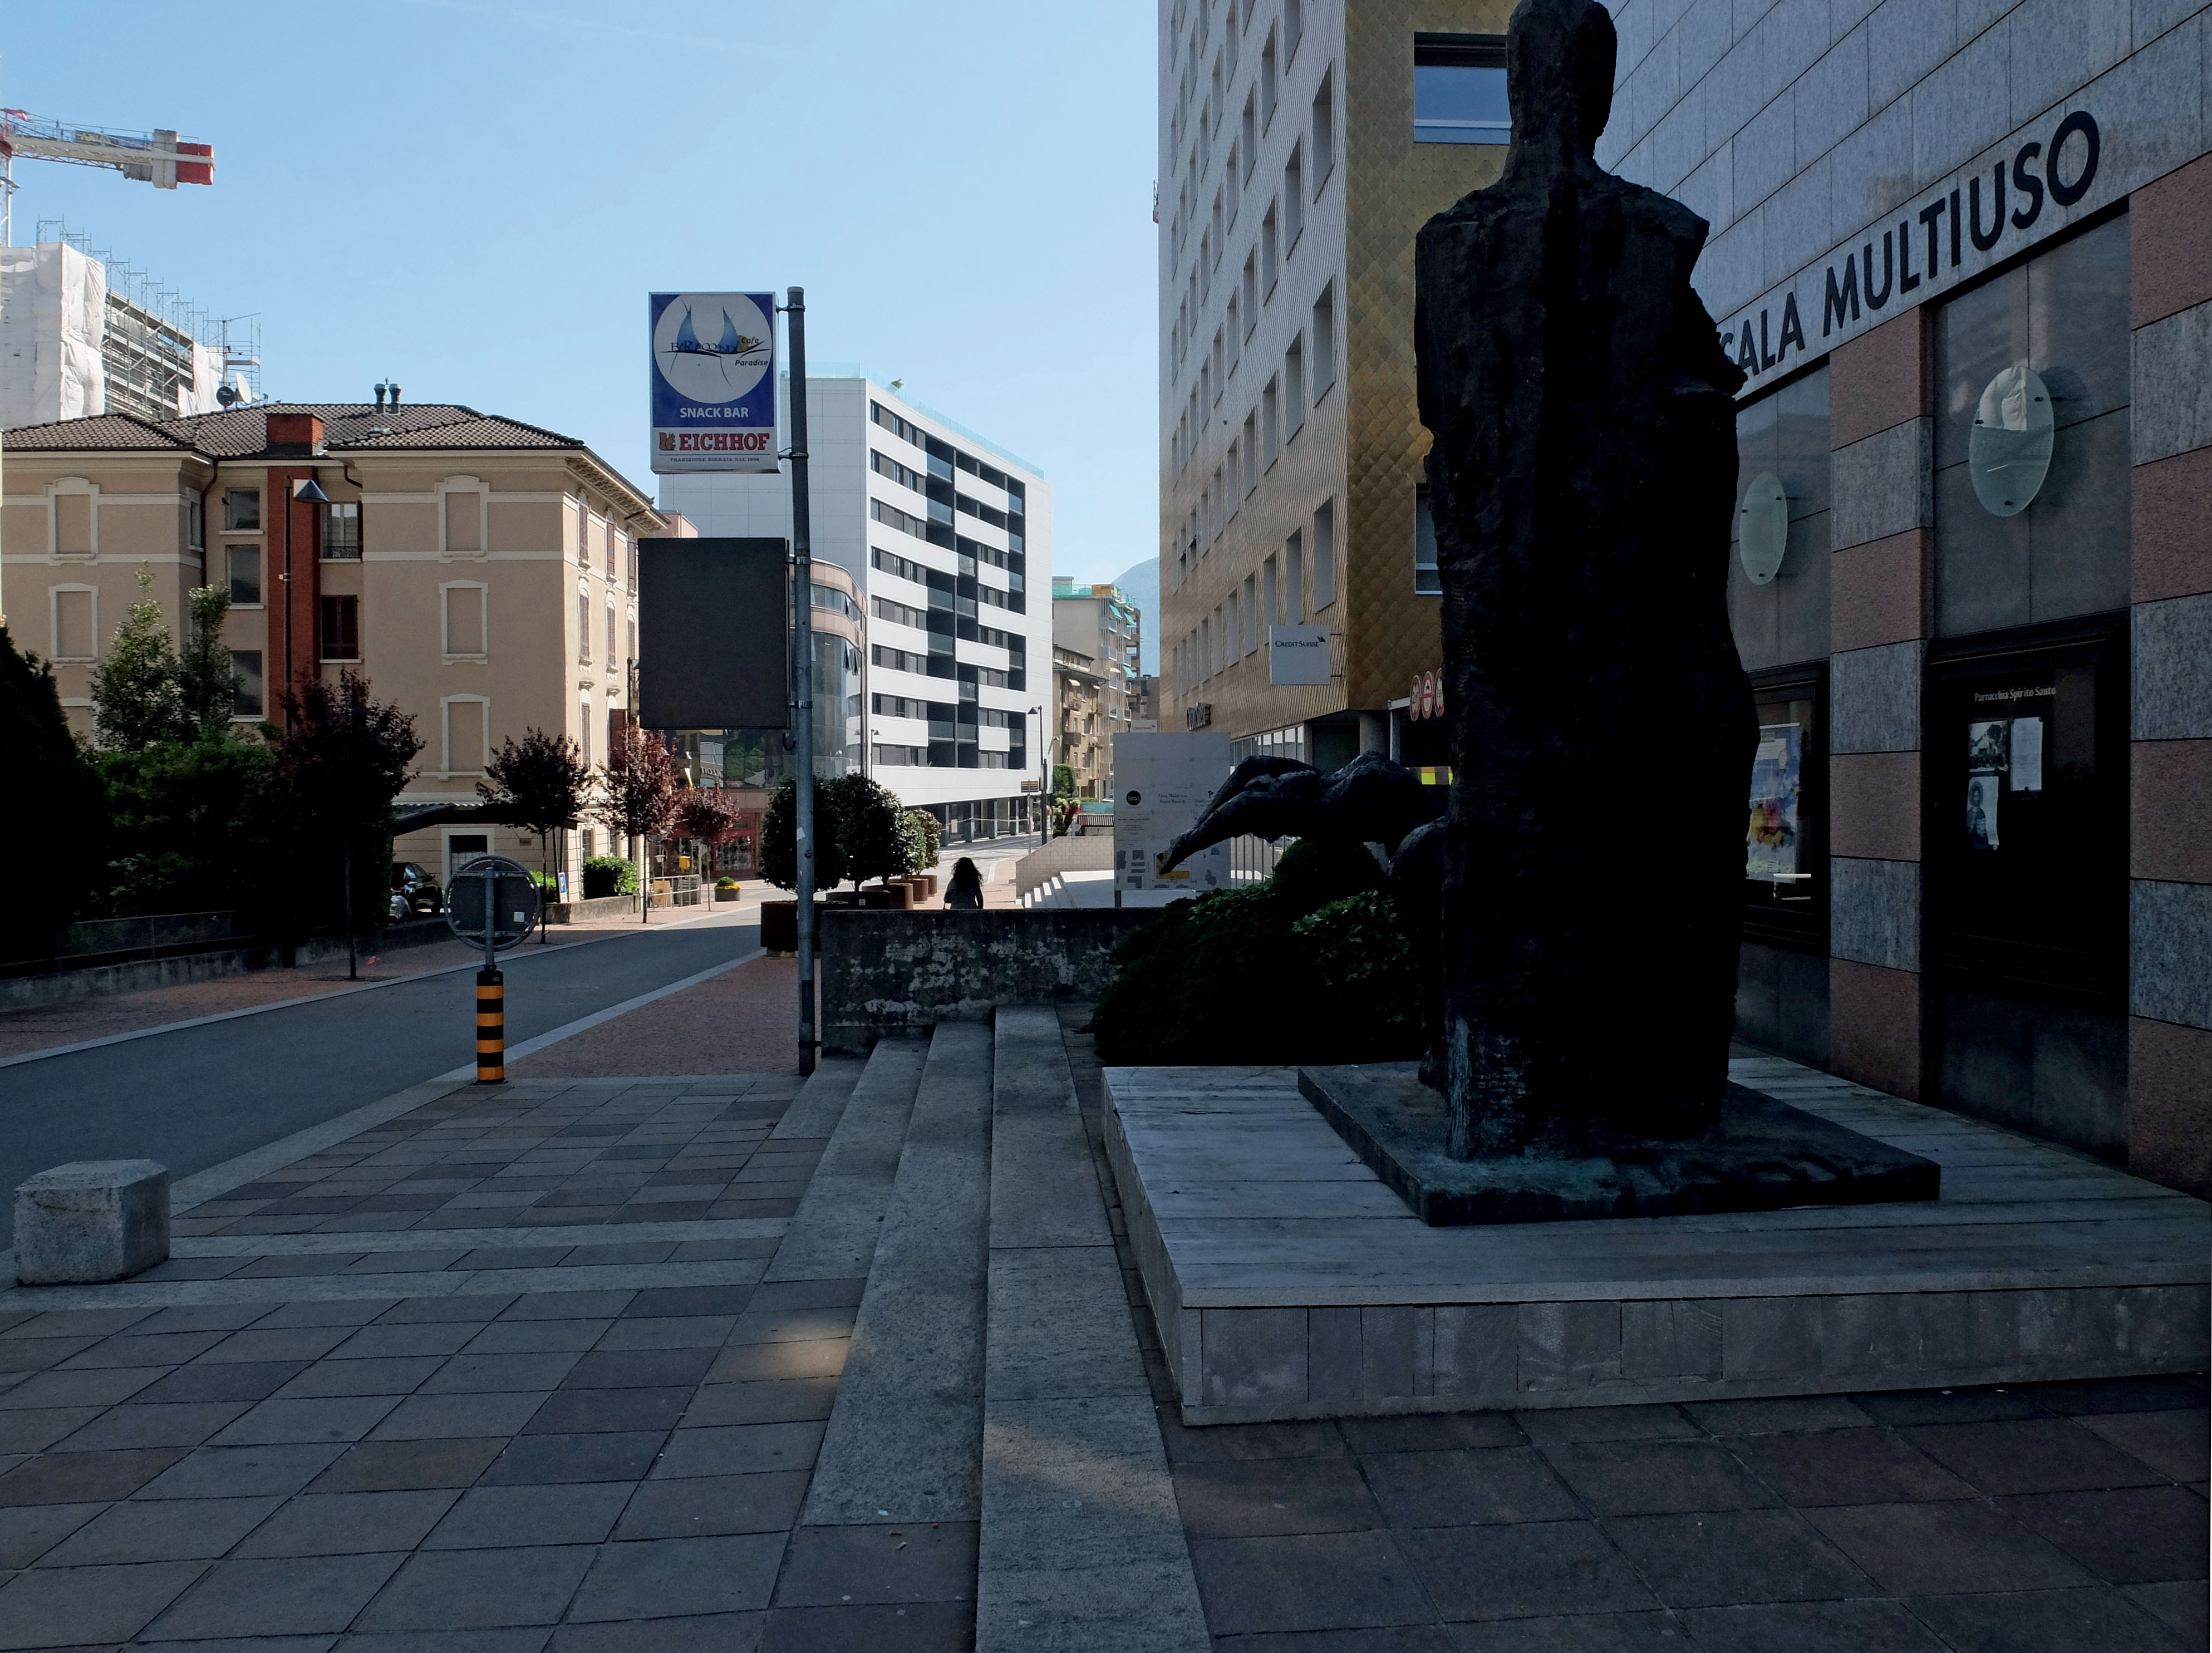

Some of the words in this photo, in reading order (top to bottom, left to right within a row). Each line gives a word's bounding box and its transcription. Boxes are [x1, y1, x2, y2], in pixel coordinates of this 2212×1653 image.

[1823, 111, 2100, 336] MULTIUSO
[680, 407, 721, 418] SNACK
[724, 407, 749, 418] BAR
[679, 432, 770, 451] EICHHOF
[1974, 691, 2008, 702] Parrocchia
[2009, 688, 2034, 701] Spirito
[2034, 686, 2057, 696] Santo
